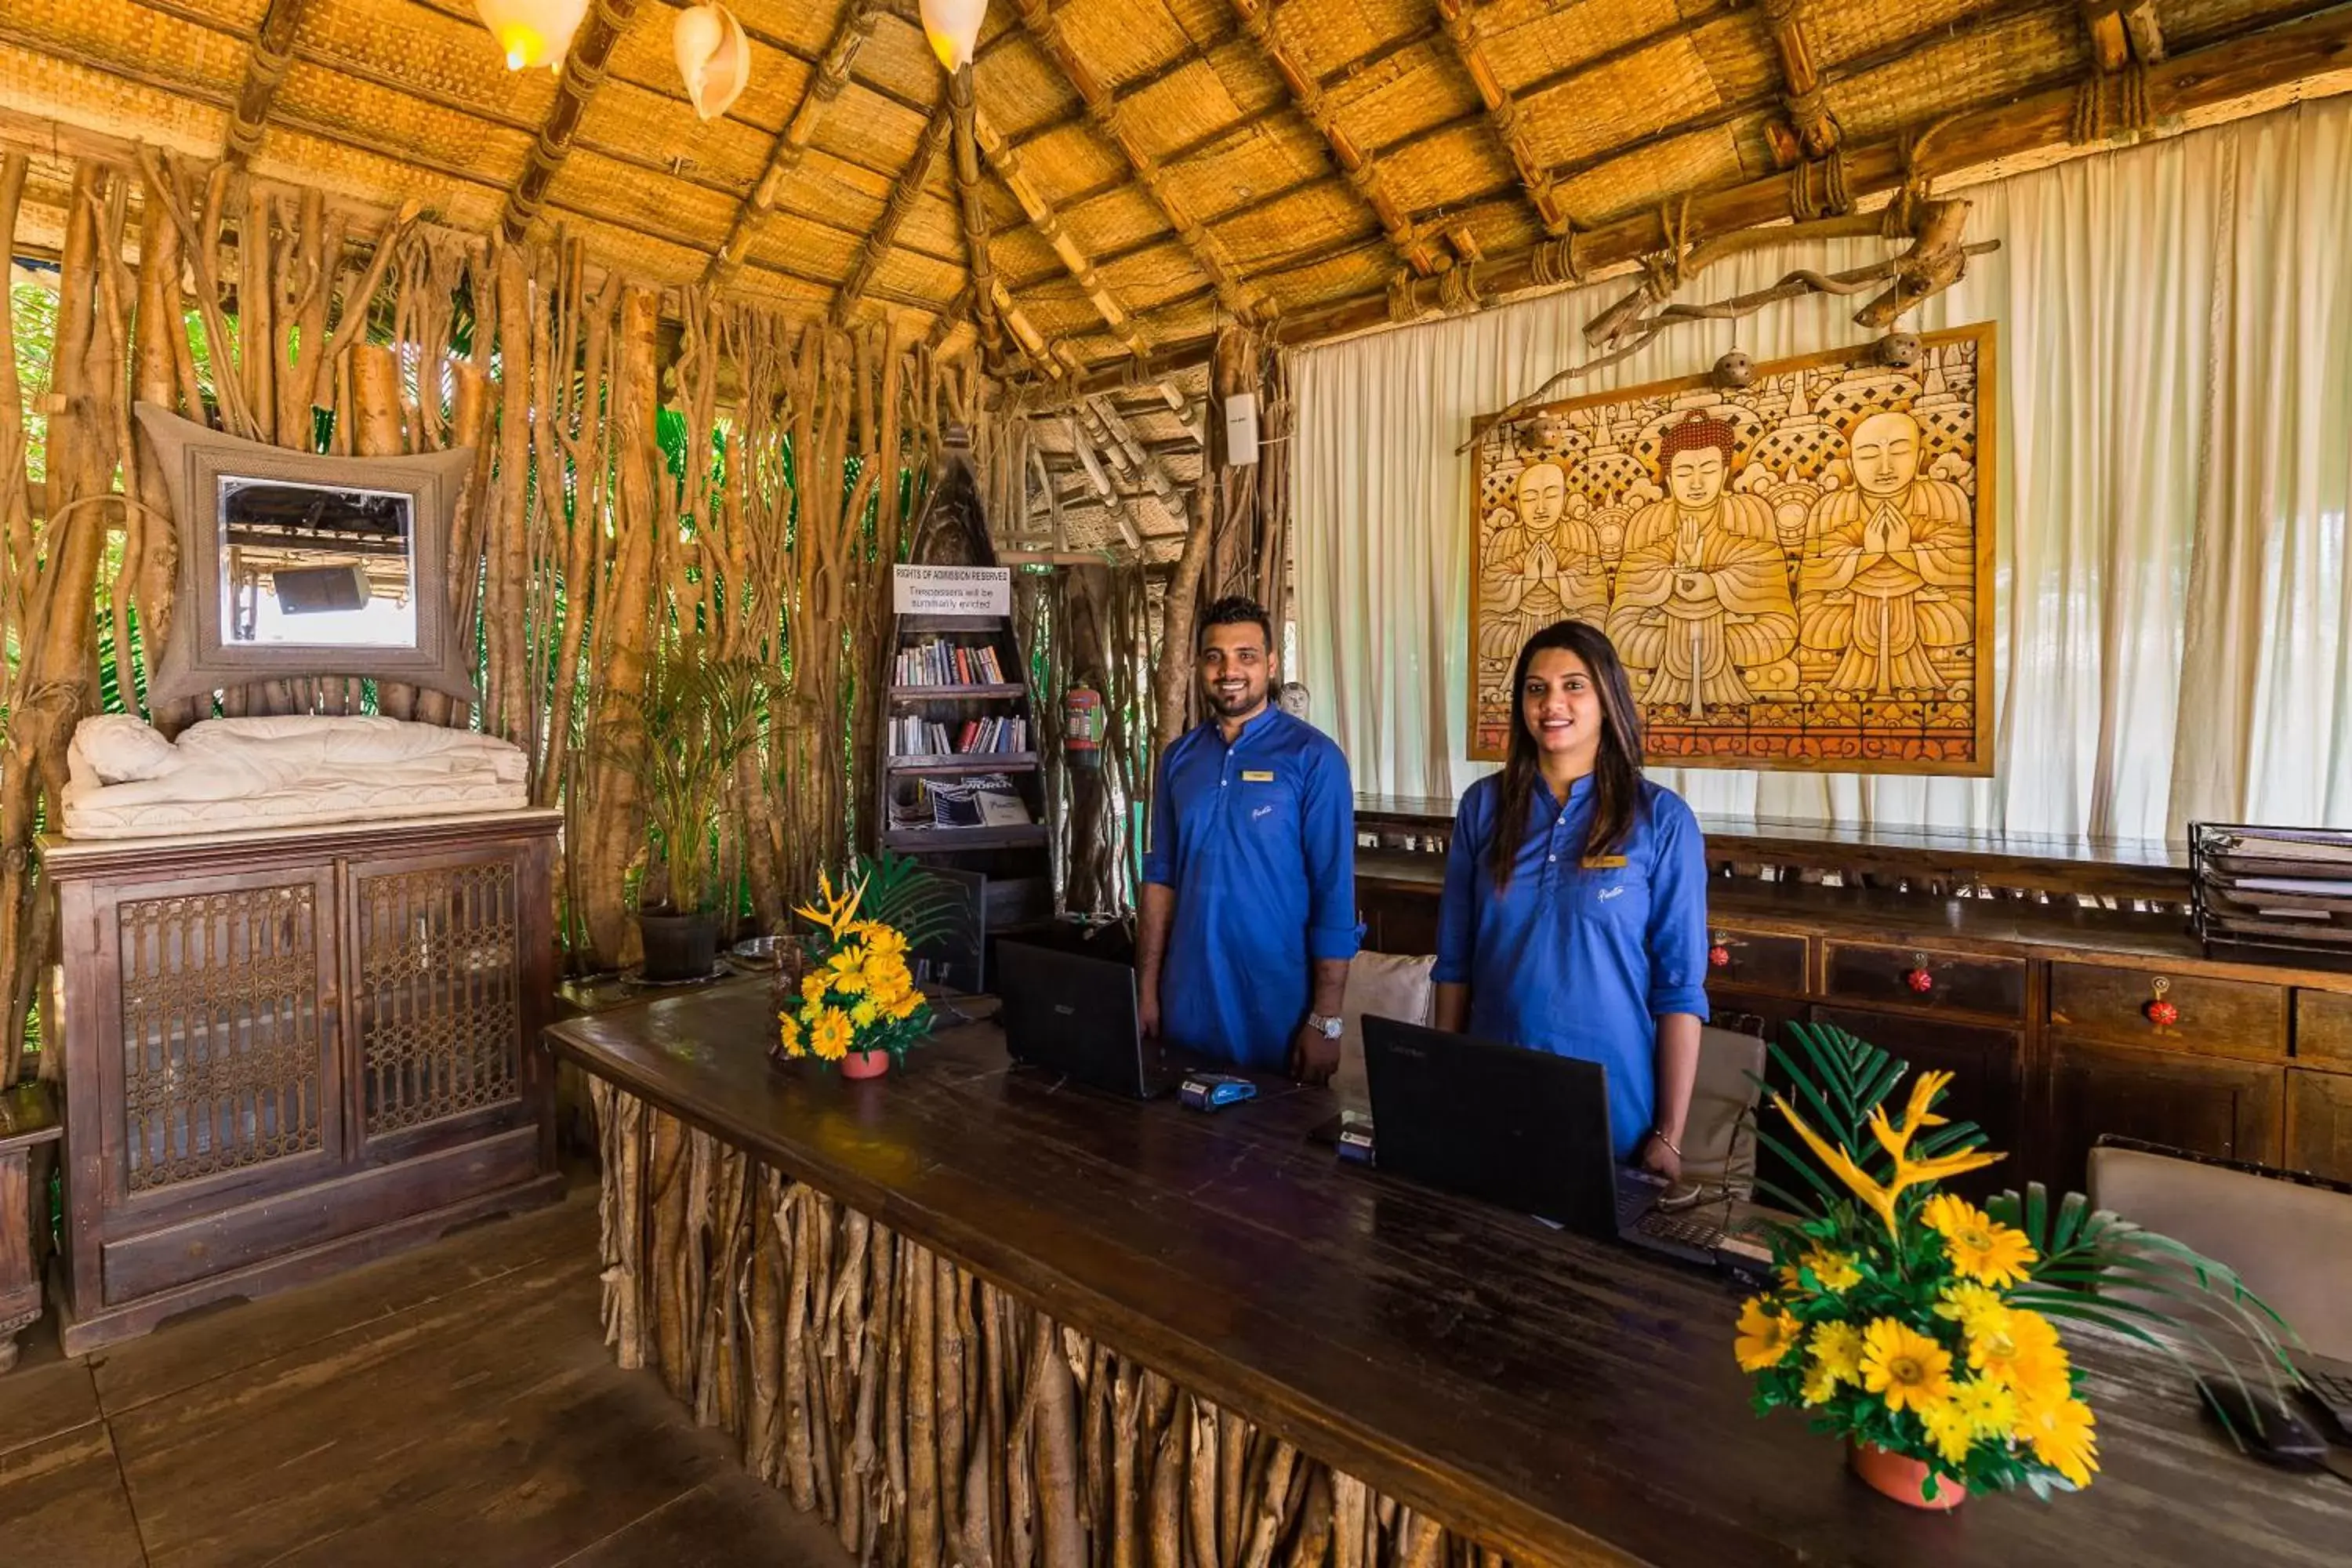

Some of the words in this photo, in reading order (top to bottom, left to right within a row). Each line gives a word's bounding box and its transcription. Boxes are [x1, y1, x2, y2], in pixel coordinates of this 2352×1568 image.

[896, 568, 921, 580] RIGHTS
[922, 570, 932, 580] OF
[933, 570, 971, 581] ADMISSION
[972, 571, 1007, 581] RESERVED
[909, 585, 964, 597] Trespassers
[965, 588, 979, 597] will
[981, 589, 993, 597] be
[911, 600, 957, 610] summarily
[959, 600, 991, 609] evicted
